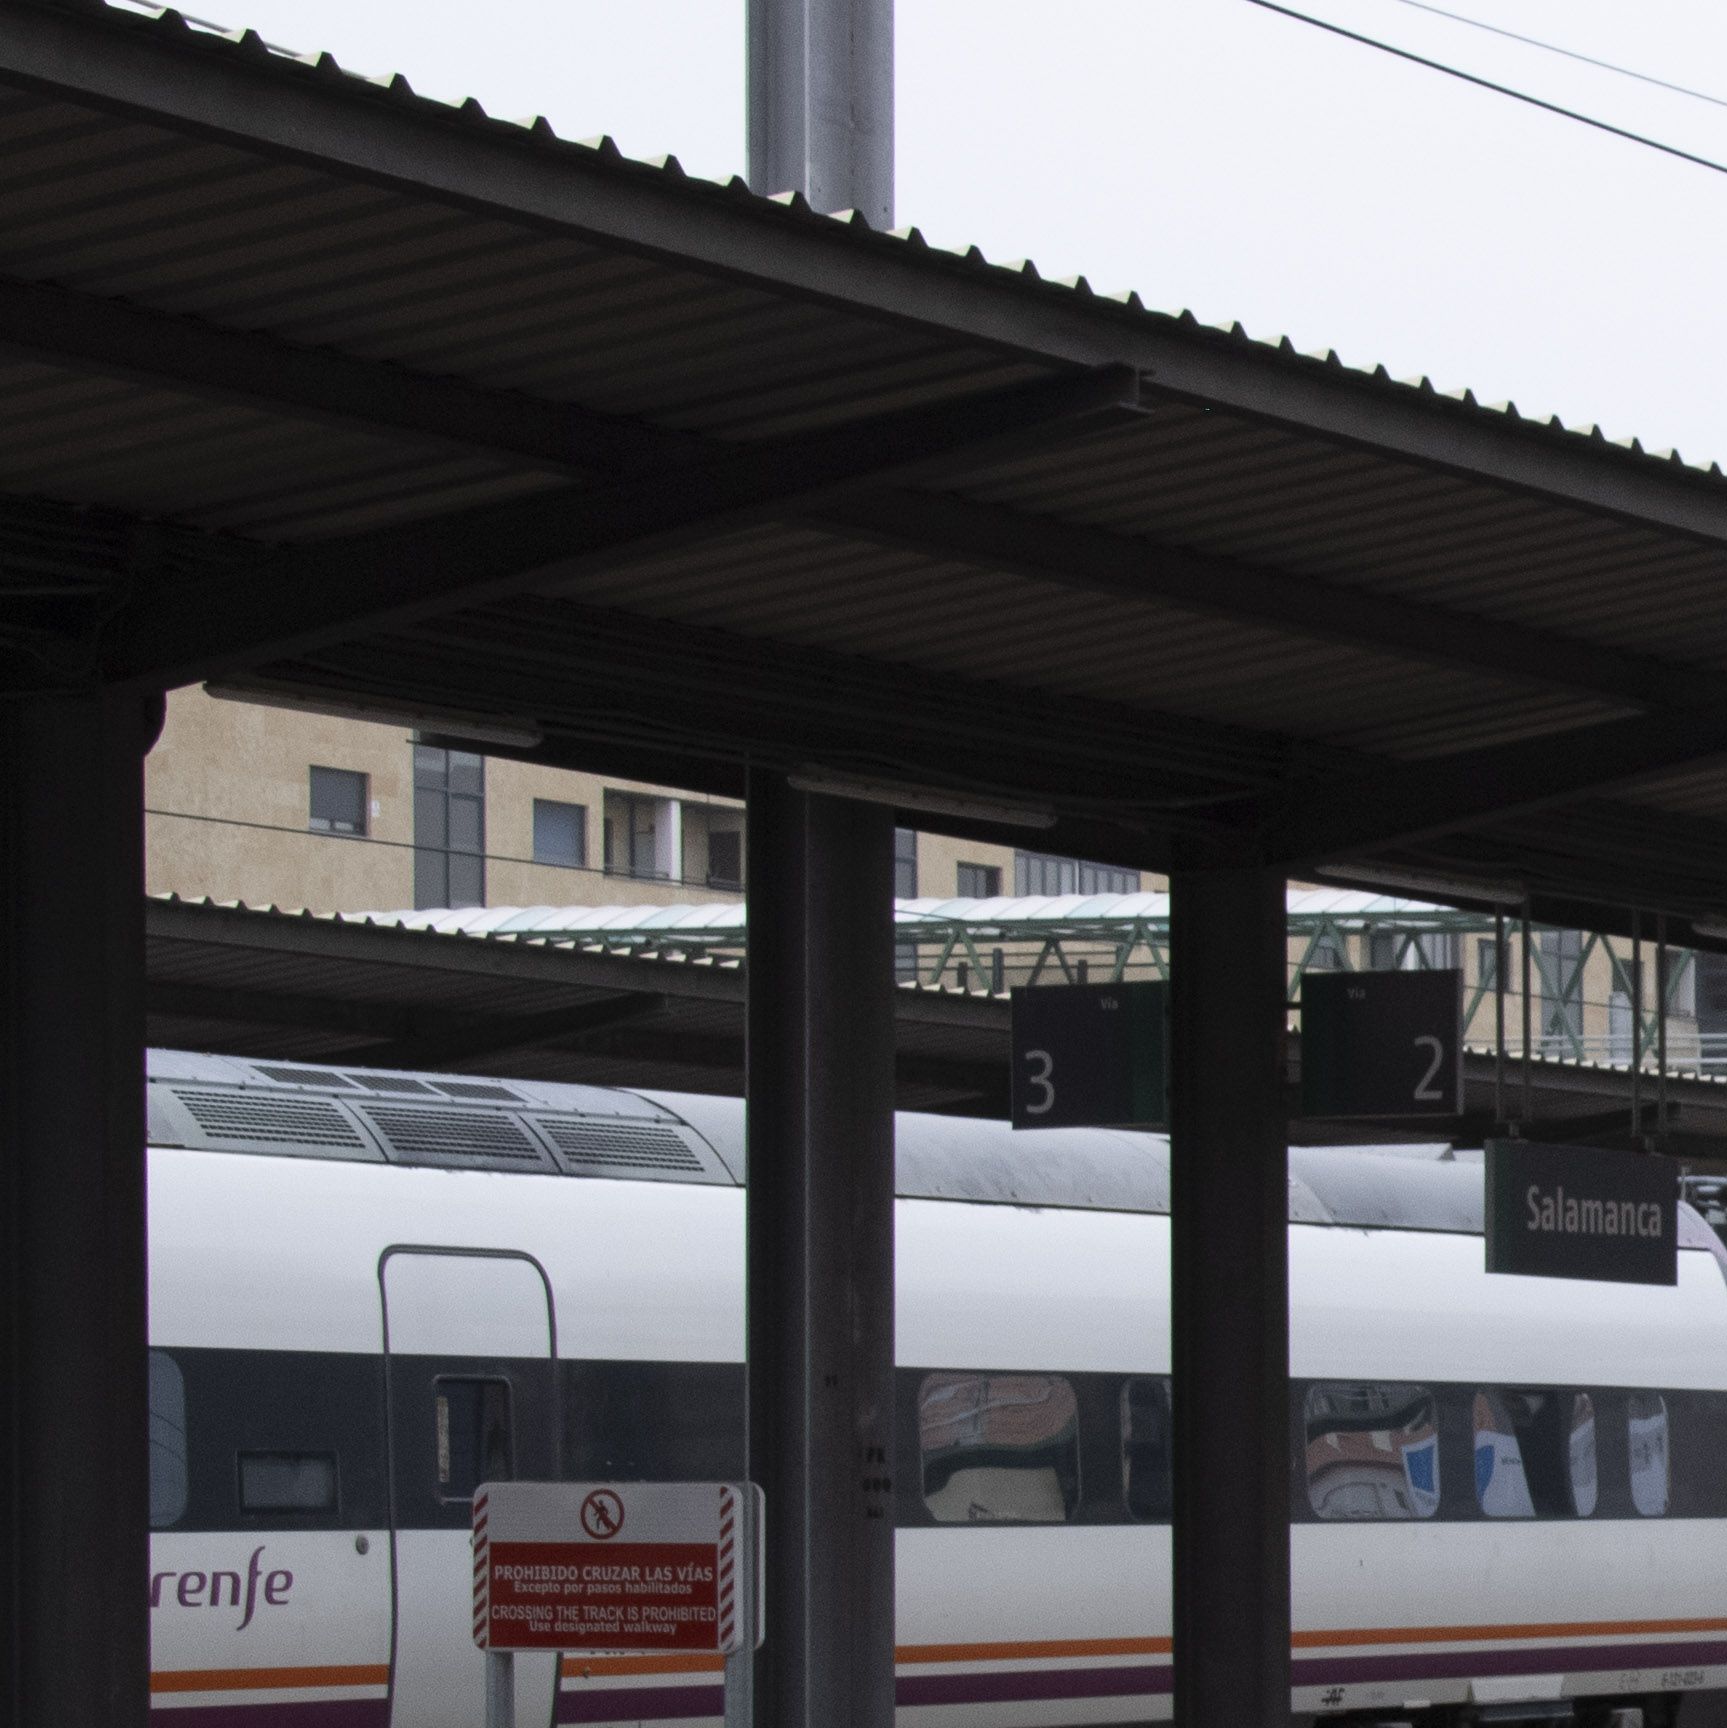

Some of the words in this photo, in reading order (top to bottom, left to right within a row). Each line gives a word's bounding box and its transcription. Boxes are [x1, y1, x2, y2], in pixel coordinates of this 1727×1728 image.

[1024, 1049, 1056, 1116] 3
[1412, 1034, 1444, 1101] 2
[1525, 1183, 1663, 1238] Salamanca
[149, 1544, 295, 1632] renfe
[493, 1564, 578, 1582] PROHIBIDO
[582, 1564, 641, 1581] CRUZAR
[645, 1565, 673, 1581] LAS
[677, 1561, 714, 1582] VÍAS
[513, 1581, 561, 1596] Excepto
[563, 1583, 584, 1596] por
[586, 1583, 622, 1596] pasos
[624, 1580, 692, 1595] habilitados
[491, 1604, 554, 1621] CROSSING
[556, 1605, 580, 1621] THE
[583, 1605, 624, 1621] TRACK
[627, 1605, 639, 1621] IS
[642, 1605, 717, 1622] PROHIBITED
[529, 1620, 551, 1633] Use
[553, 1620, 620, 1635] designated
[623, 1620, 678, 1635] walkway
